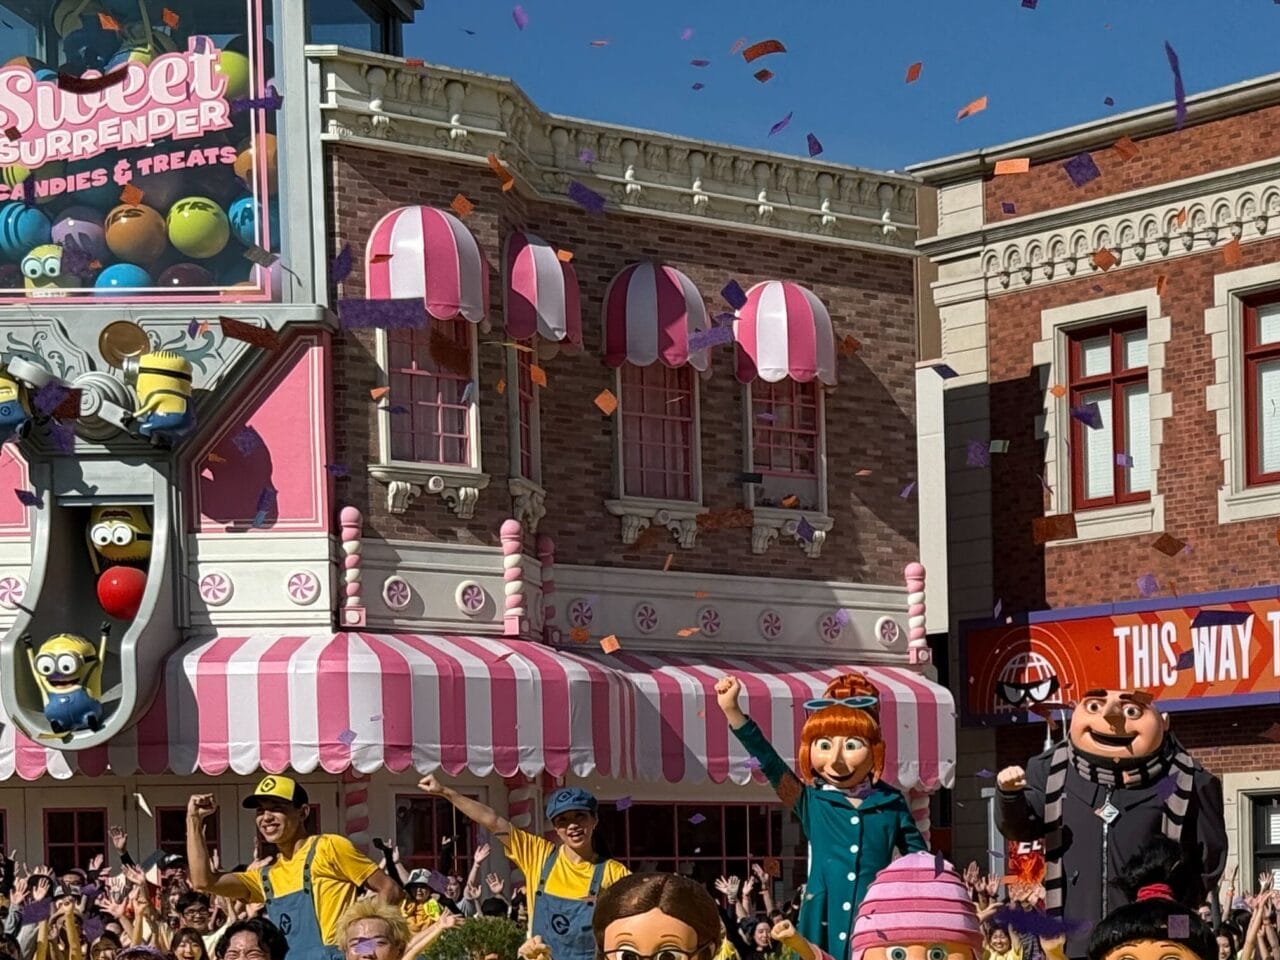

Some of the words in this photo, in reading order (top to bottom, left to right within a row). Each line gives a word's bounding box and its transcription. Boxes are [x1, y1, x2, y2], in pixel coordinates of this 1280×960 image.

[0, 100, 228, 165] SURRENDER
[113, 158, 133, 187] &
[136, 146, 238, 177] TREATS
[1113, 620, 1178, 690] THIS
[1190, 613, 1255, 684] WAY
